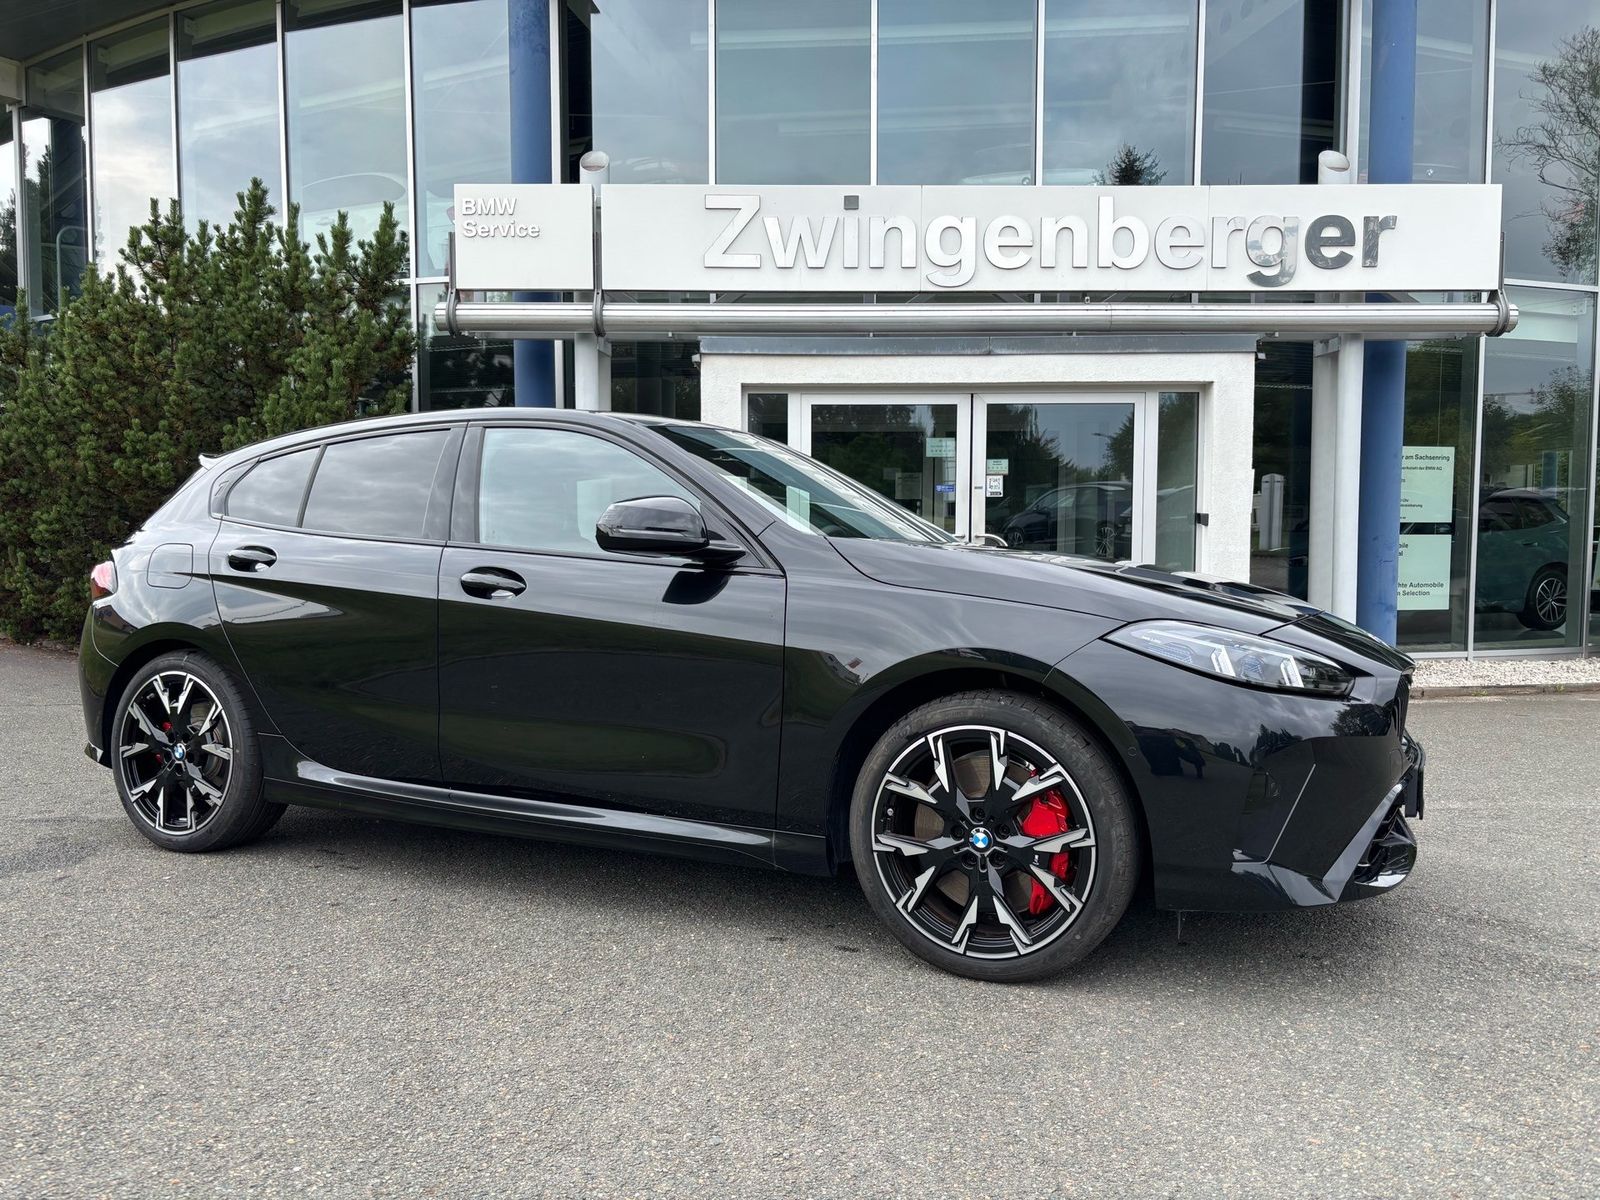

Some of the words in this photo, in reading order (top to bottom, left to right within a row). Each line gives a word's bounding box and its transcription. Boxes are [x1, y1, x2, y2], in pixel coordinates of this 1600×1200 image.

[462, 197, 517, 216] BMW
[463, 220, 540, 238] Service
[703, 194, 1397, 288] Zwingenberger
[1414, 453, 1450, 462] Sachsenring
